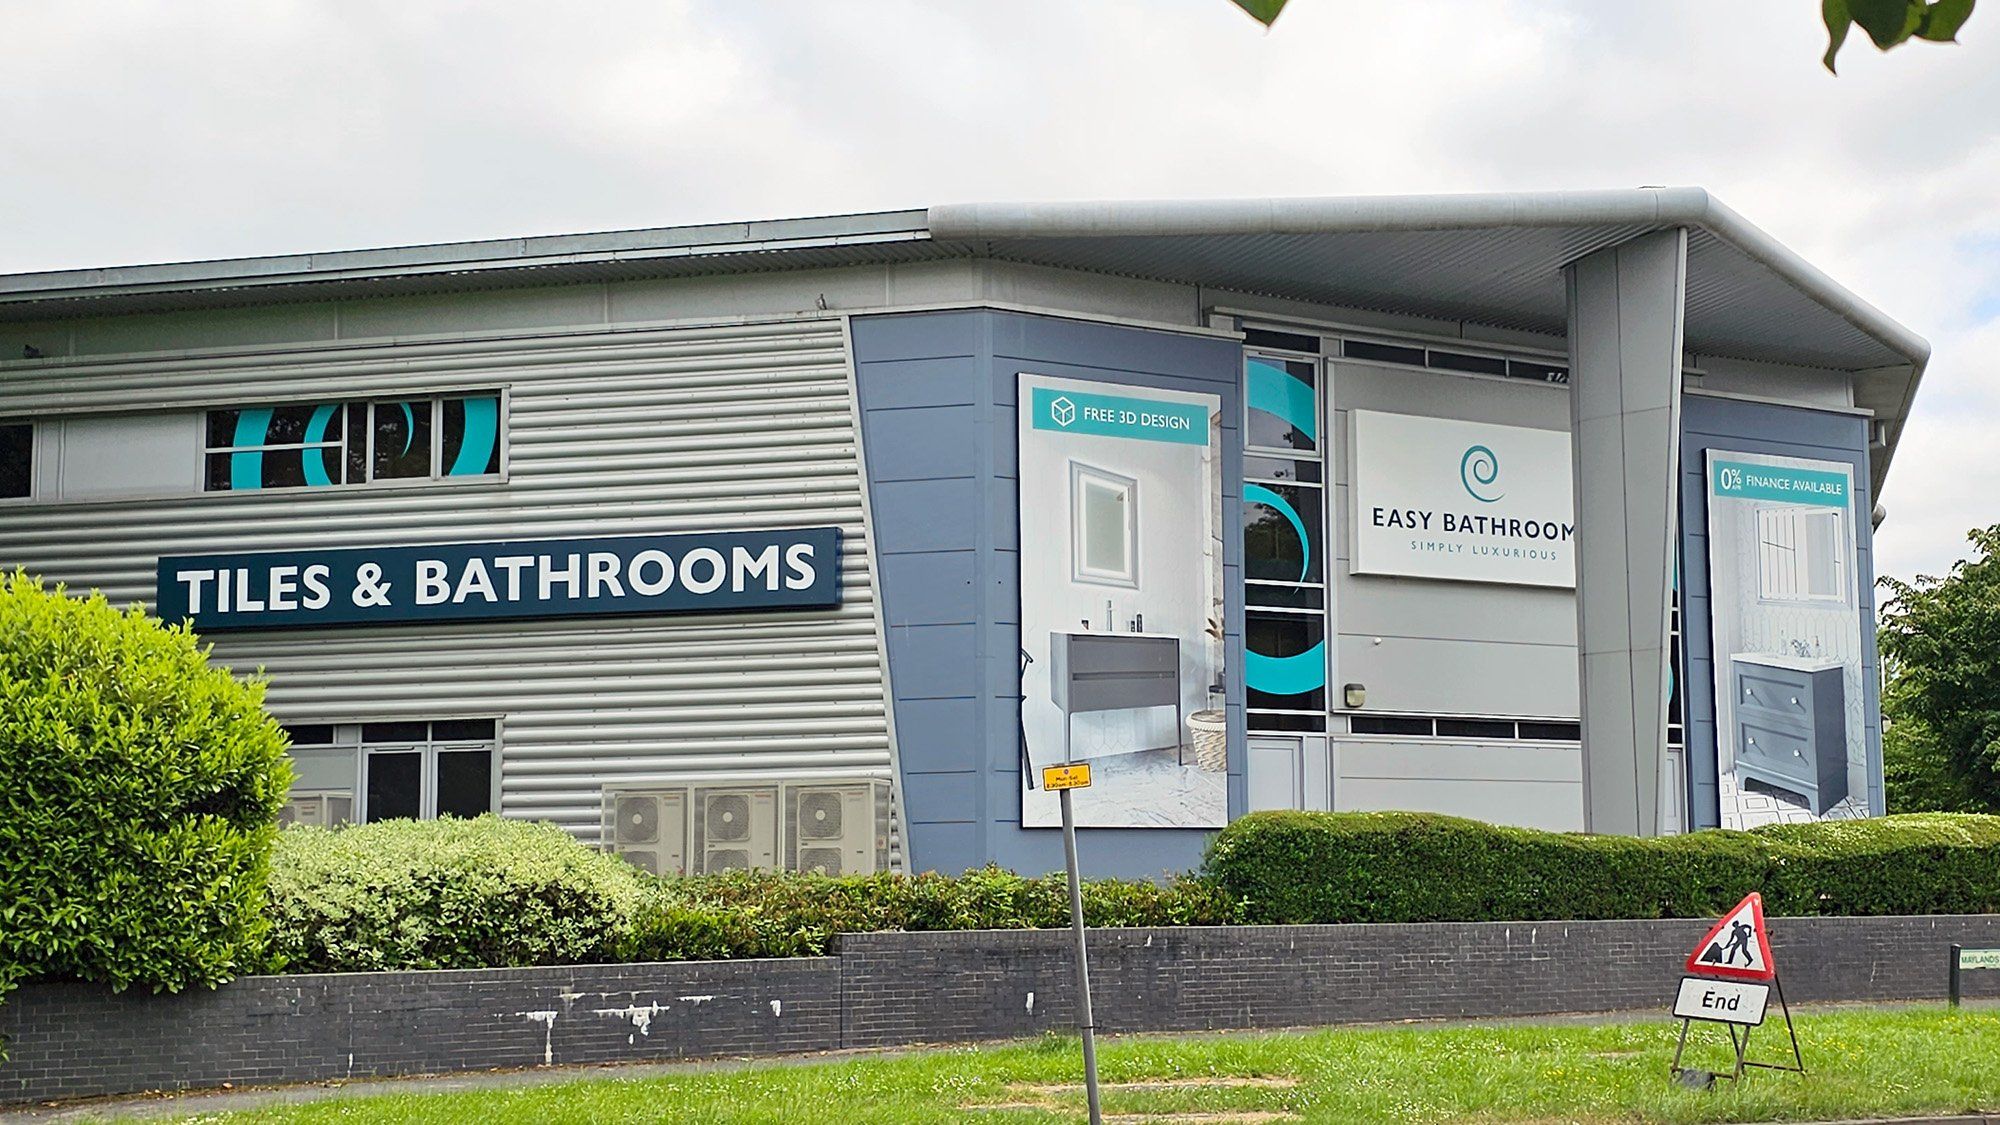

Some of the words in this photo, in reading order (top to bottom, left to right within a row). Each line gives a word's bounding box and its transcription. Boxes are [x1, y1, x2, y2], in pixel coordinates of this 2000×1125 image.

[1084, 407, 1115, 423] FREE
[1119, 411, 1137, 425] 3D
[1141, 413, 1190, 430] DESIGN
[1721, 468, 1742, 490] 0%
[1746, 475, 1790, 491] FINANCE
[1792, 480, 1842, 495] AVAILABLE
[1373, 507, 1433, 530] EASY
[1443, 513, 1575, 541] BATHROOM
[1411, 540, 1464, 553] SIMPLY
[1473, 545, 1557, 561] LUXURIOUS
[177, 563, 332, 615] TILES
[352, 562, 393, 610] &
[415, 544, 816, 606] BATHROOMS
[1702, 991, 1741, 1011] End
